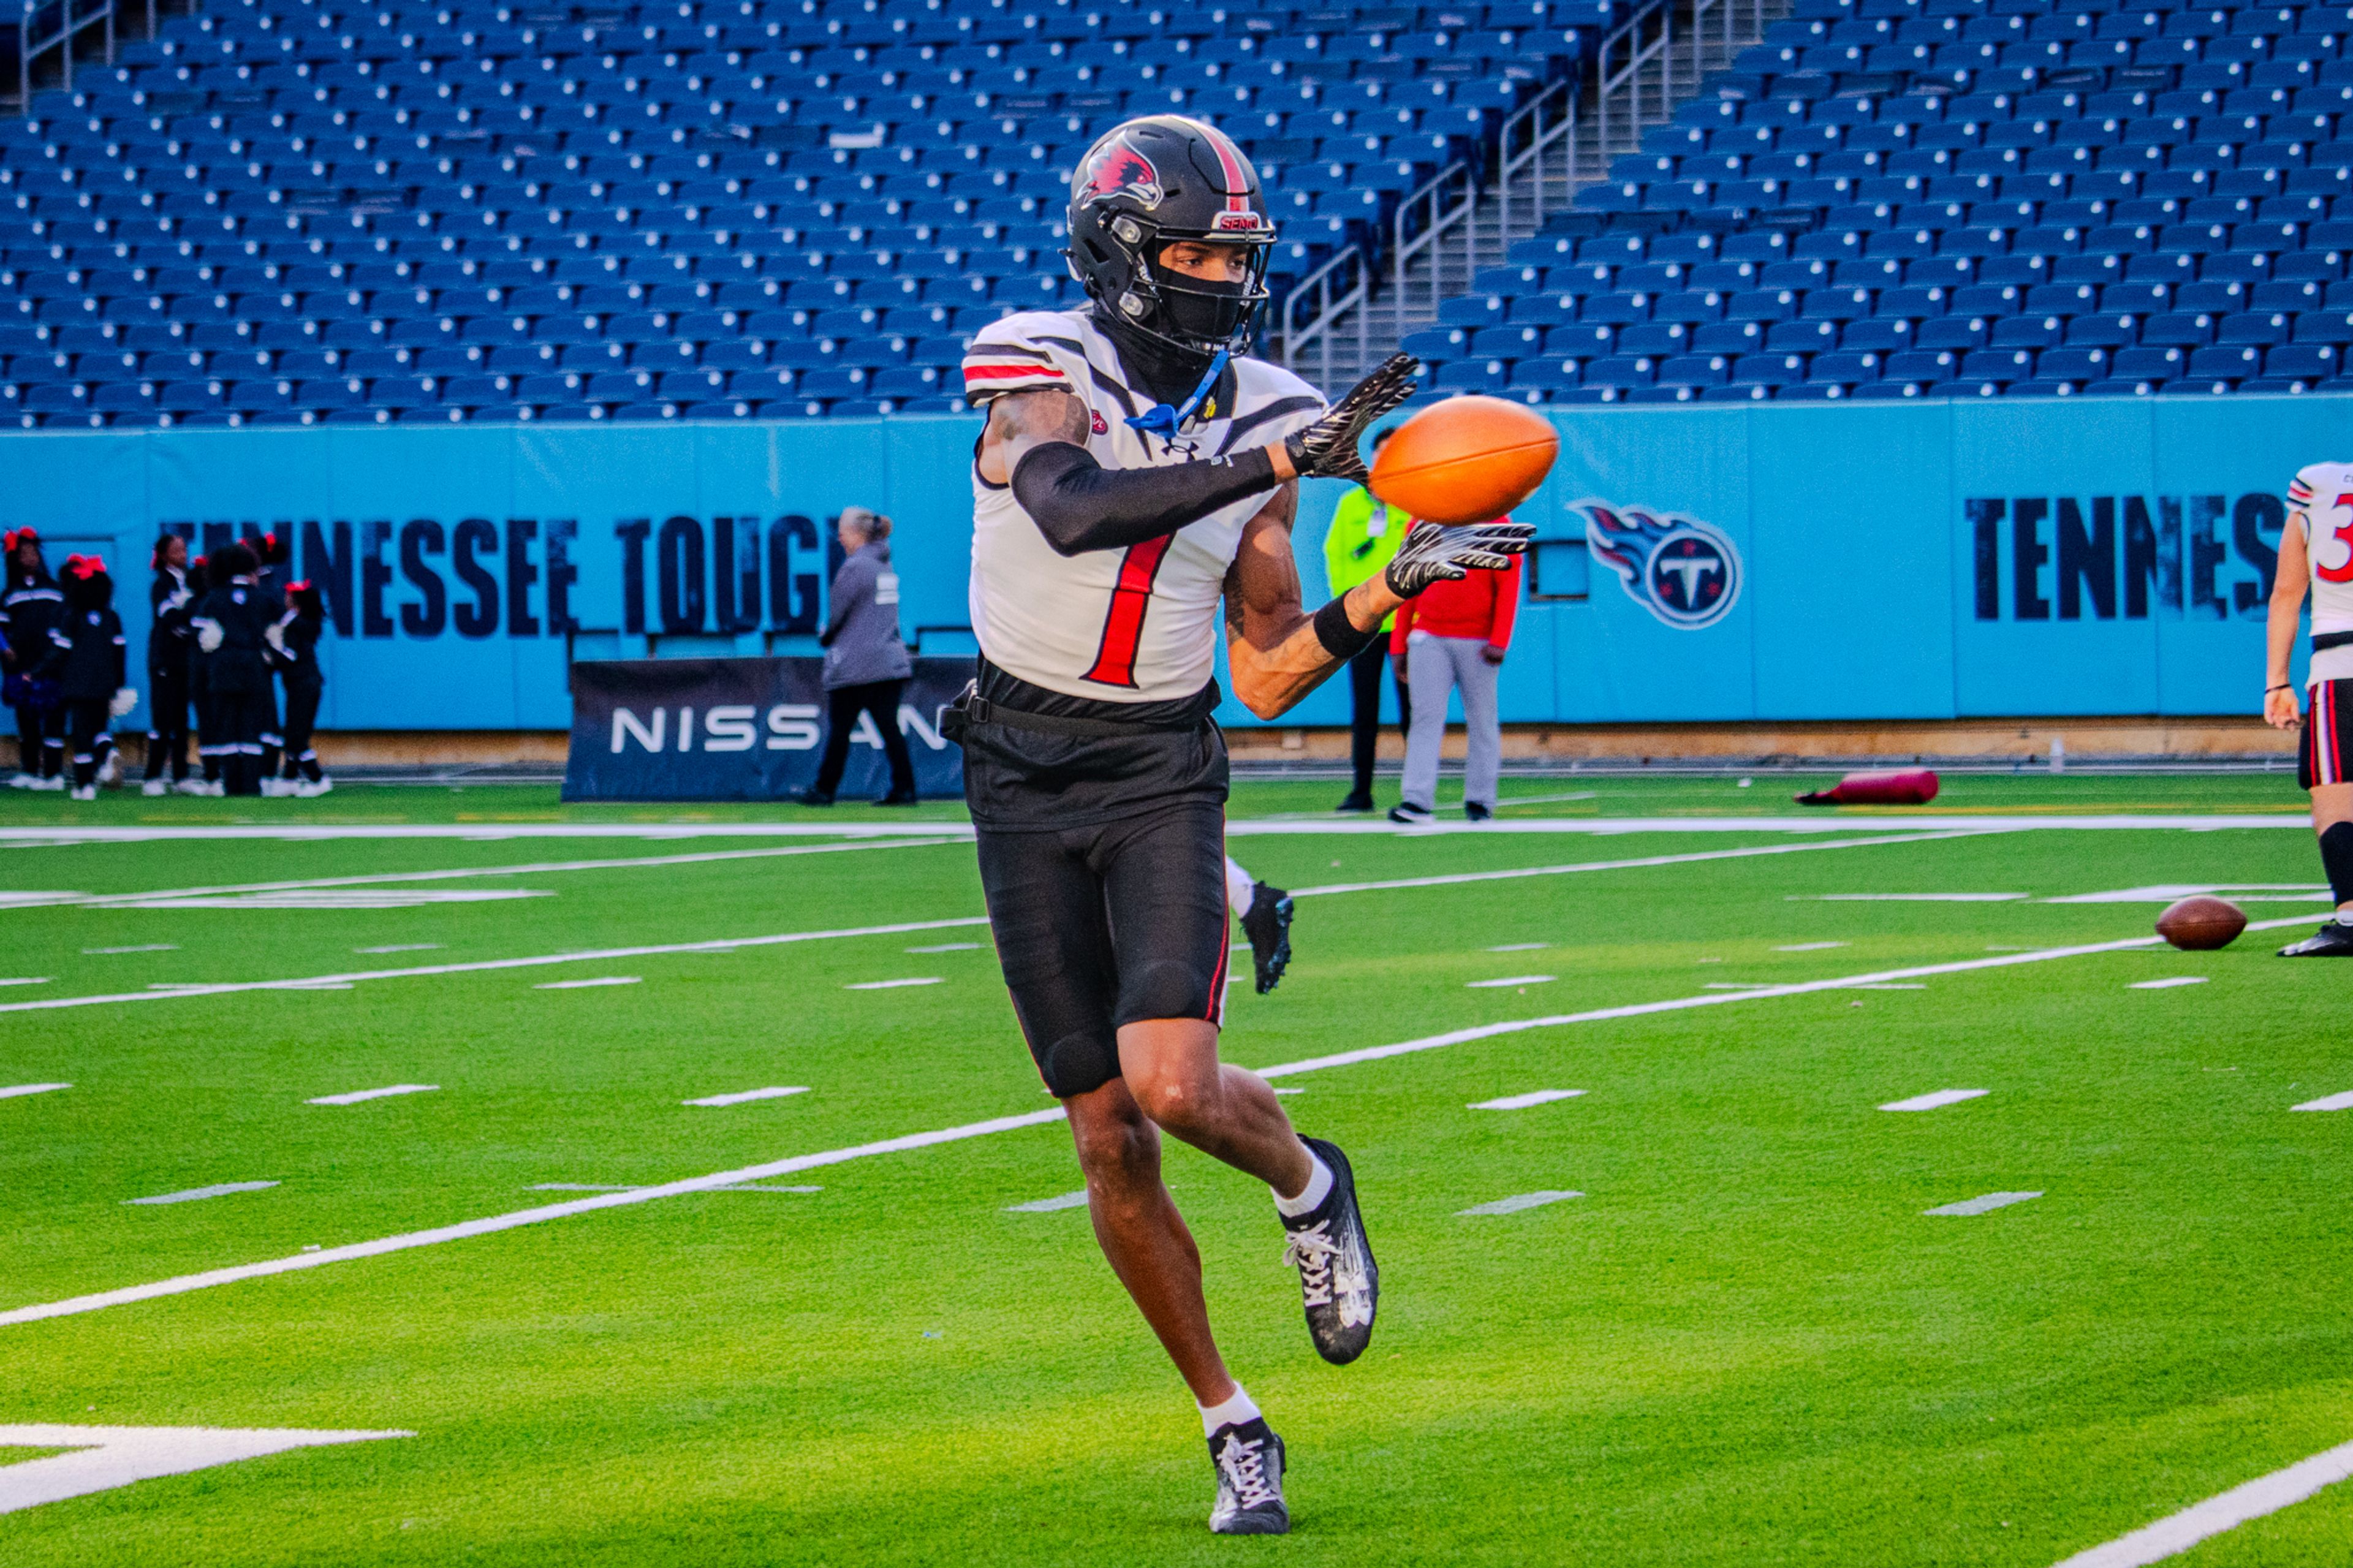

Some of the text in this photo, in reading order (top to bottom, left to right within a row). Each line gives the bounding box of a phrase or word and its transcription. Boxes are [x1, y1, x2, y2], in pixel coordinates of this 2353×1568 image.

[1219, 215, 1259, 230] SEMO
[159, 518, 579, 638] NESSEE
[615, 514, 849, 635] TOUG
[1078, 527, 1178, 690] 1
